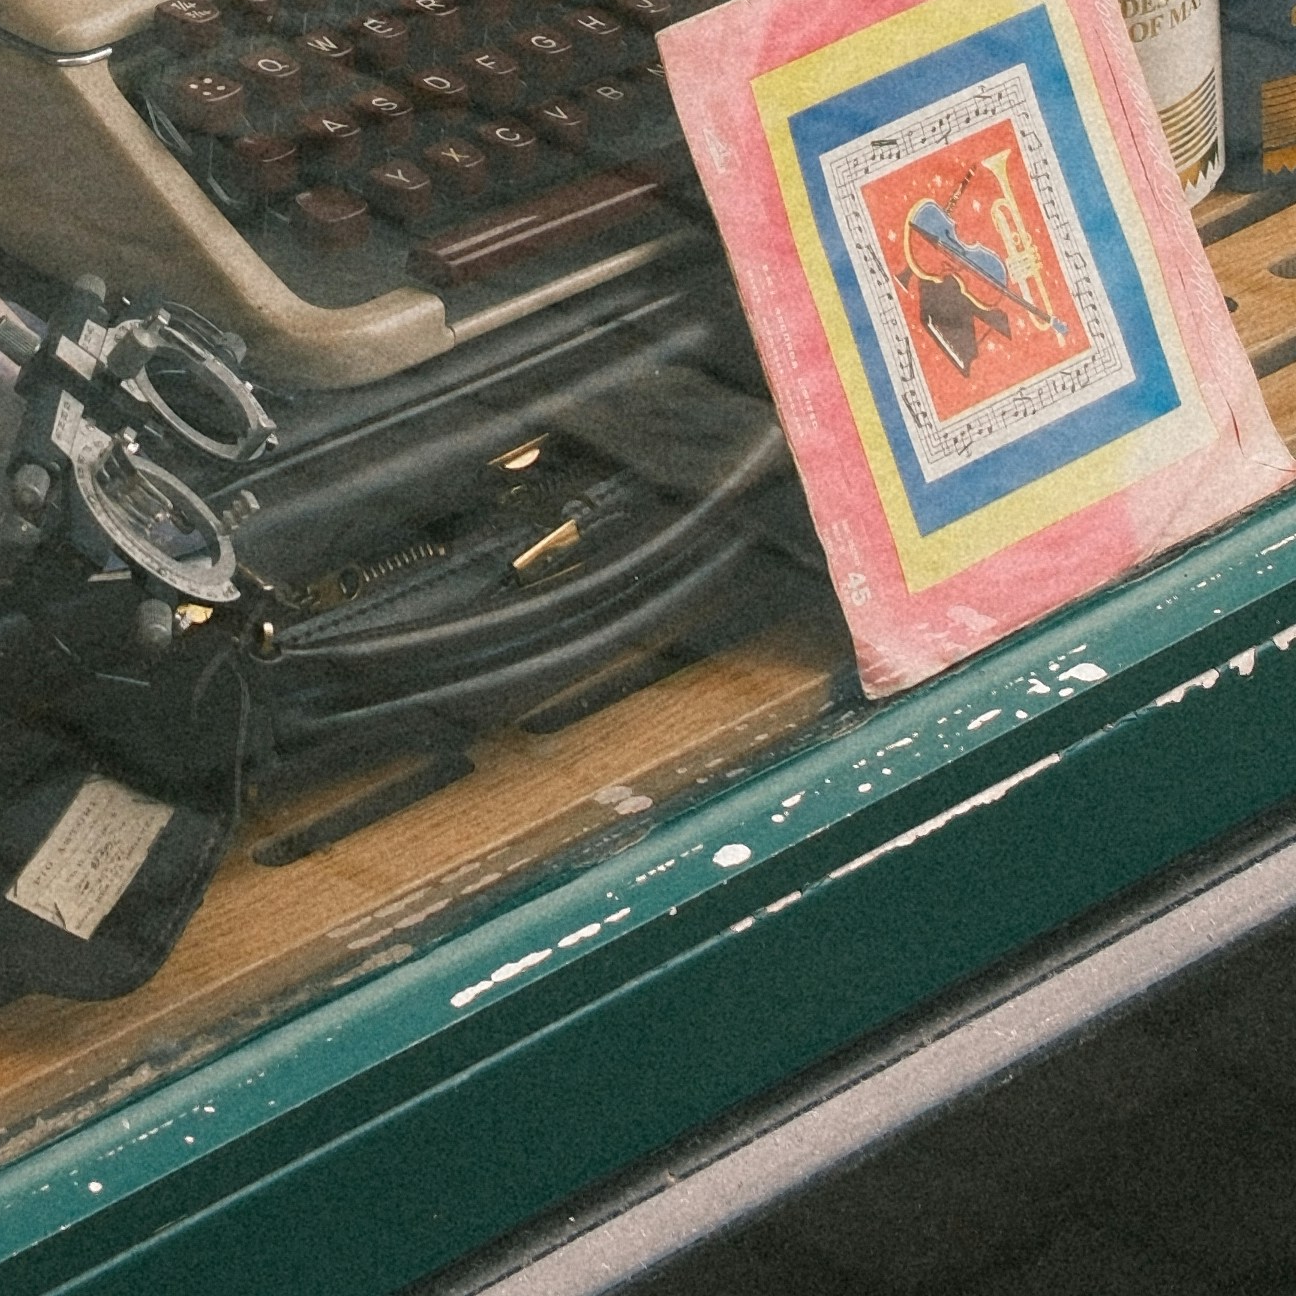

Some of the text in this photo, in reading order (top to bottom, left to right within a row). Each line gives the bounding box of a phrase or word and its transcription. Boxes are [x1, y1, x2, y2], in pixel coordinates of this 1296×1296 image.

[257, 57, 289, 74] Q
[307, 35, 341, 52] W
[363, 18, 394, 35] E
[1128, 13, 1165, 44] OF
[321, 118, 348, 134] A
[371, 96, 398, 113] S
[422, 76, 452, 92] D
[475, 54, 502, 71] F
[530, 34, 558, 51] G
[577, 14, 607, 31] H
[385, 168, 411, 184] Y
[441, 146, 470, 163] X
[495, 127, 521, 143] C
[596, 86, 625, 101] B
[847, 572, 872, 606] 45
